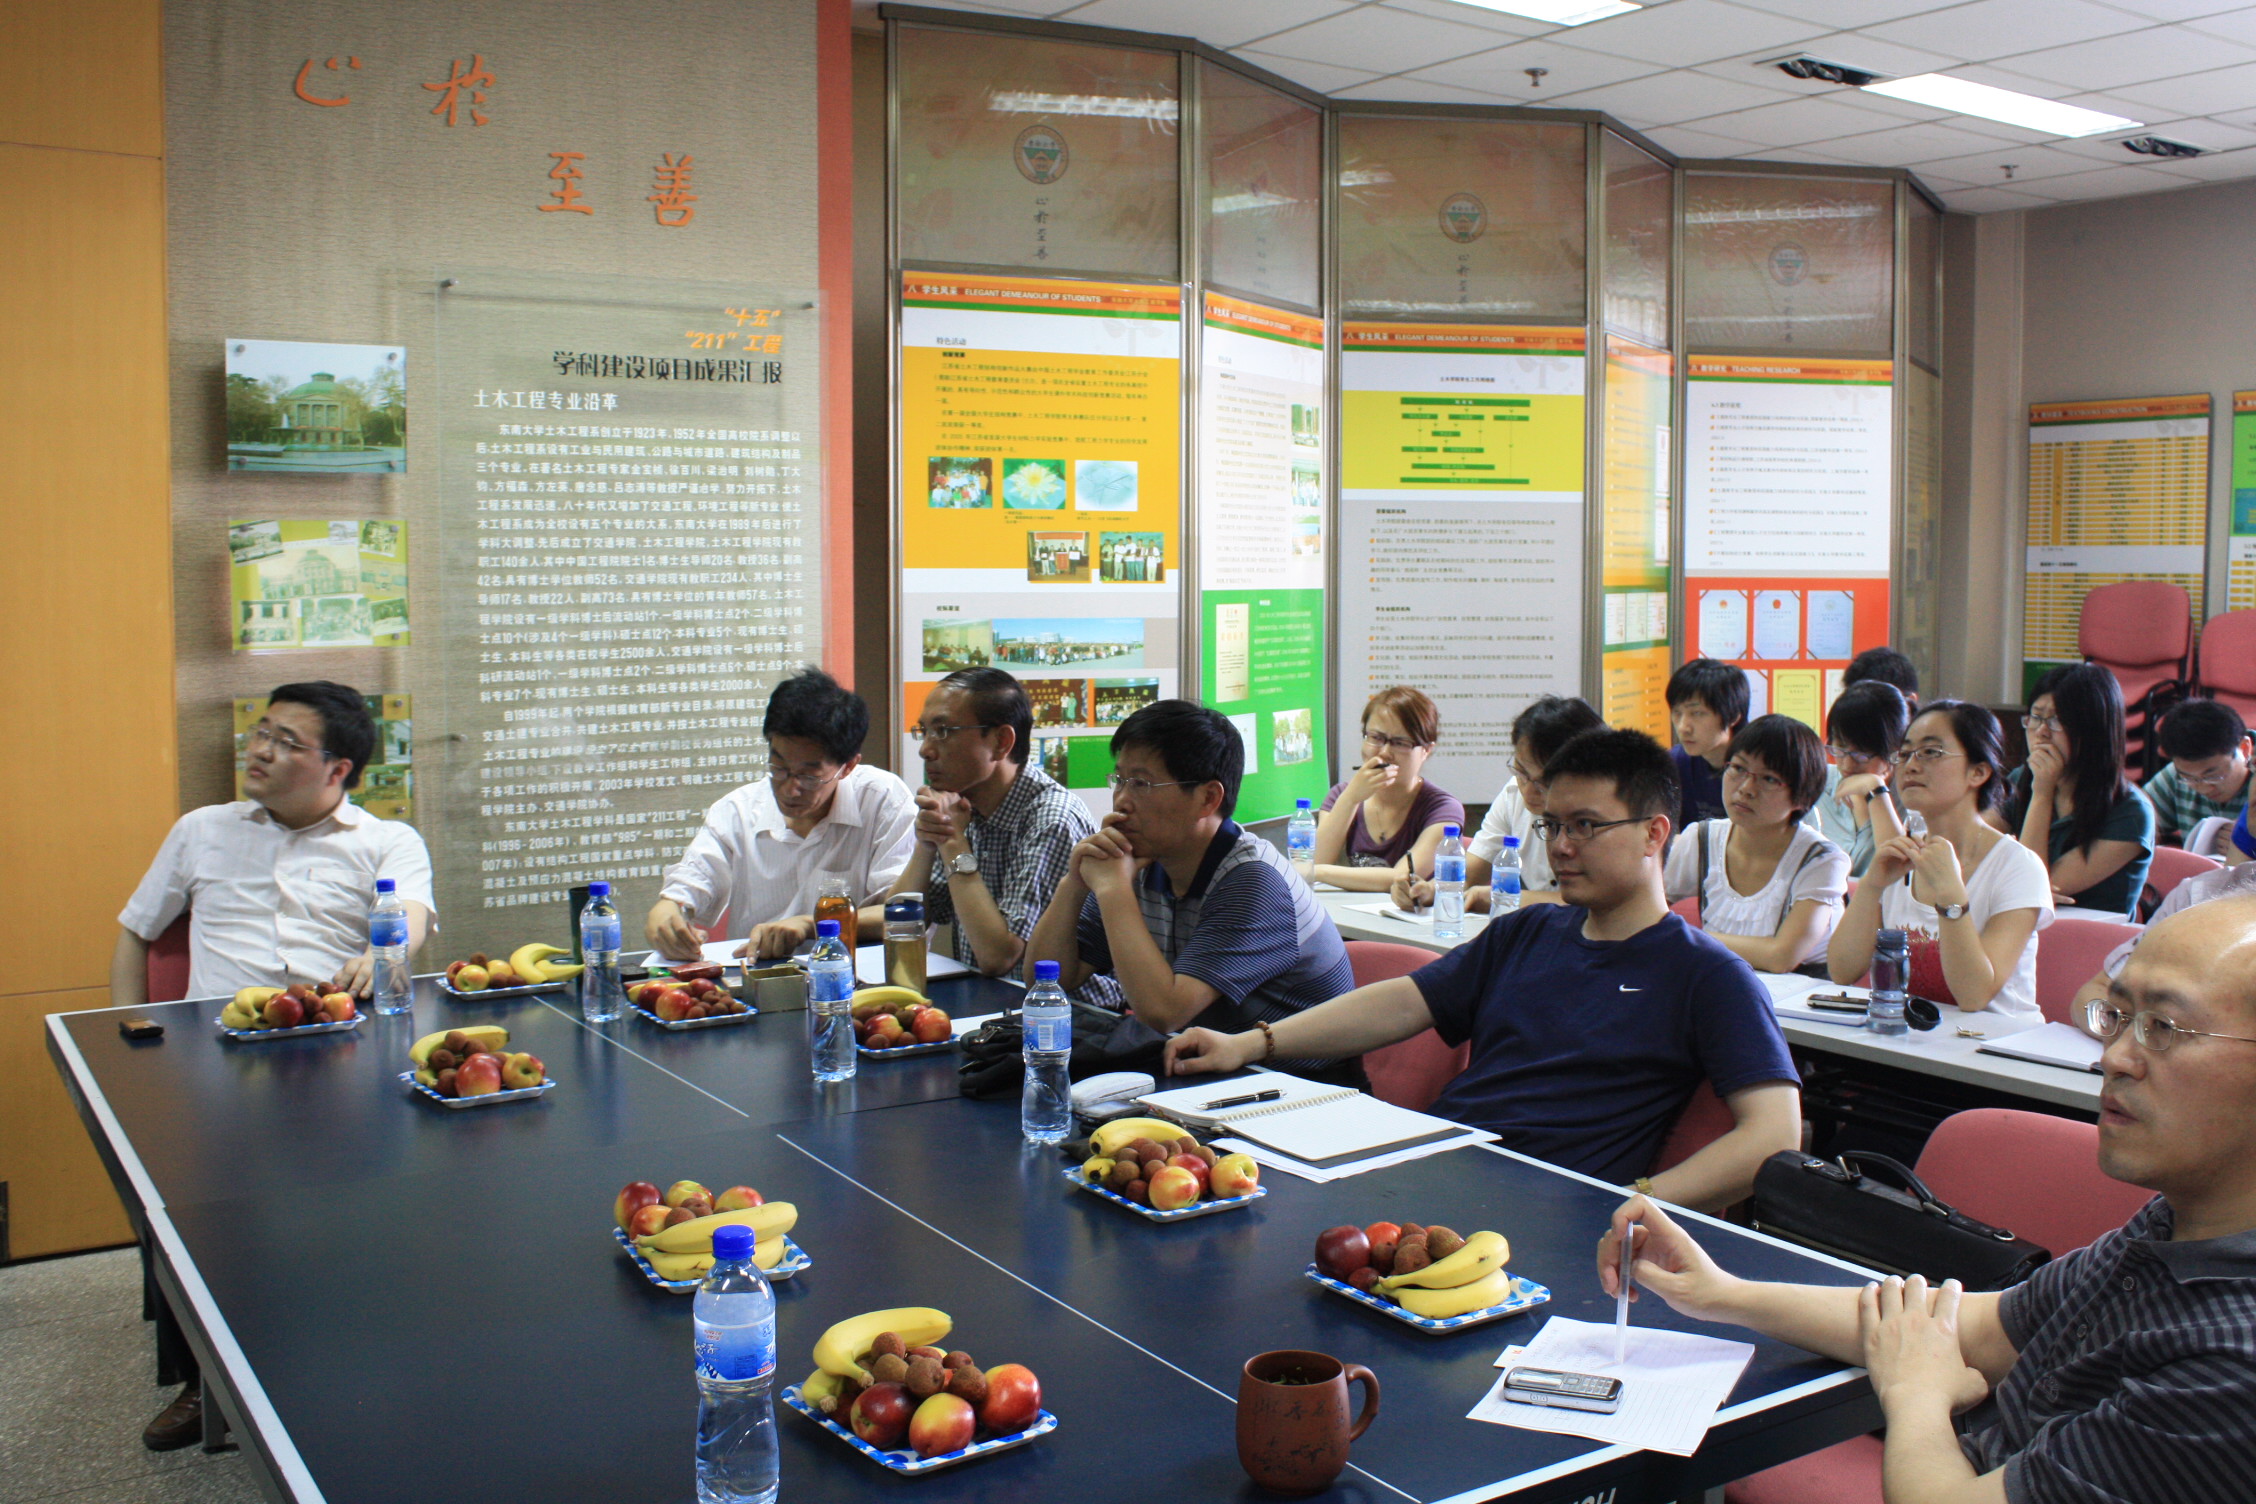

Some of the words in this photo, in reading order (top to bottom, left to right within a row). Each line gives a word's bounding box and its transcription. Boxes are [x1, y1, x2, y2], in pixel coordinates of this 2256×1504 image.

[921, 286, 958, 295] 学生风采
[965, 288, 1000, 297] ELEGANT
[1001, 290, 1050, 300] DEMEANOUR
[1062, 295, 1102, 303] STUDENTS
[742, 334, 783, 354] 工程
[553, 350, 782, 385] 学科建设项目成果汇报
[473, 390, 619, 411] 土木工程专业沿革
